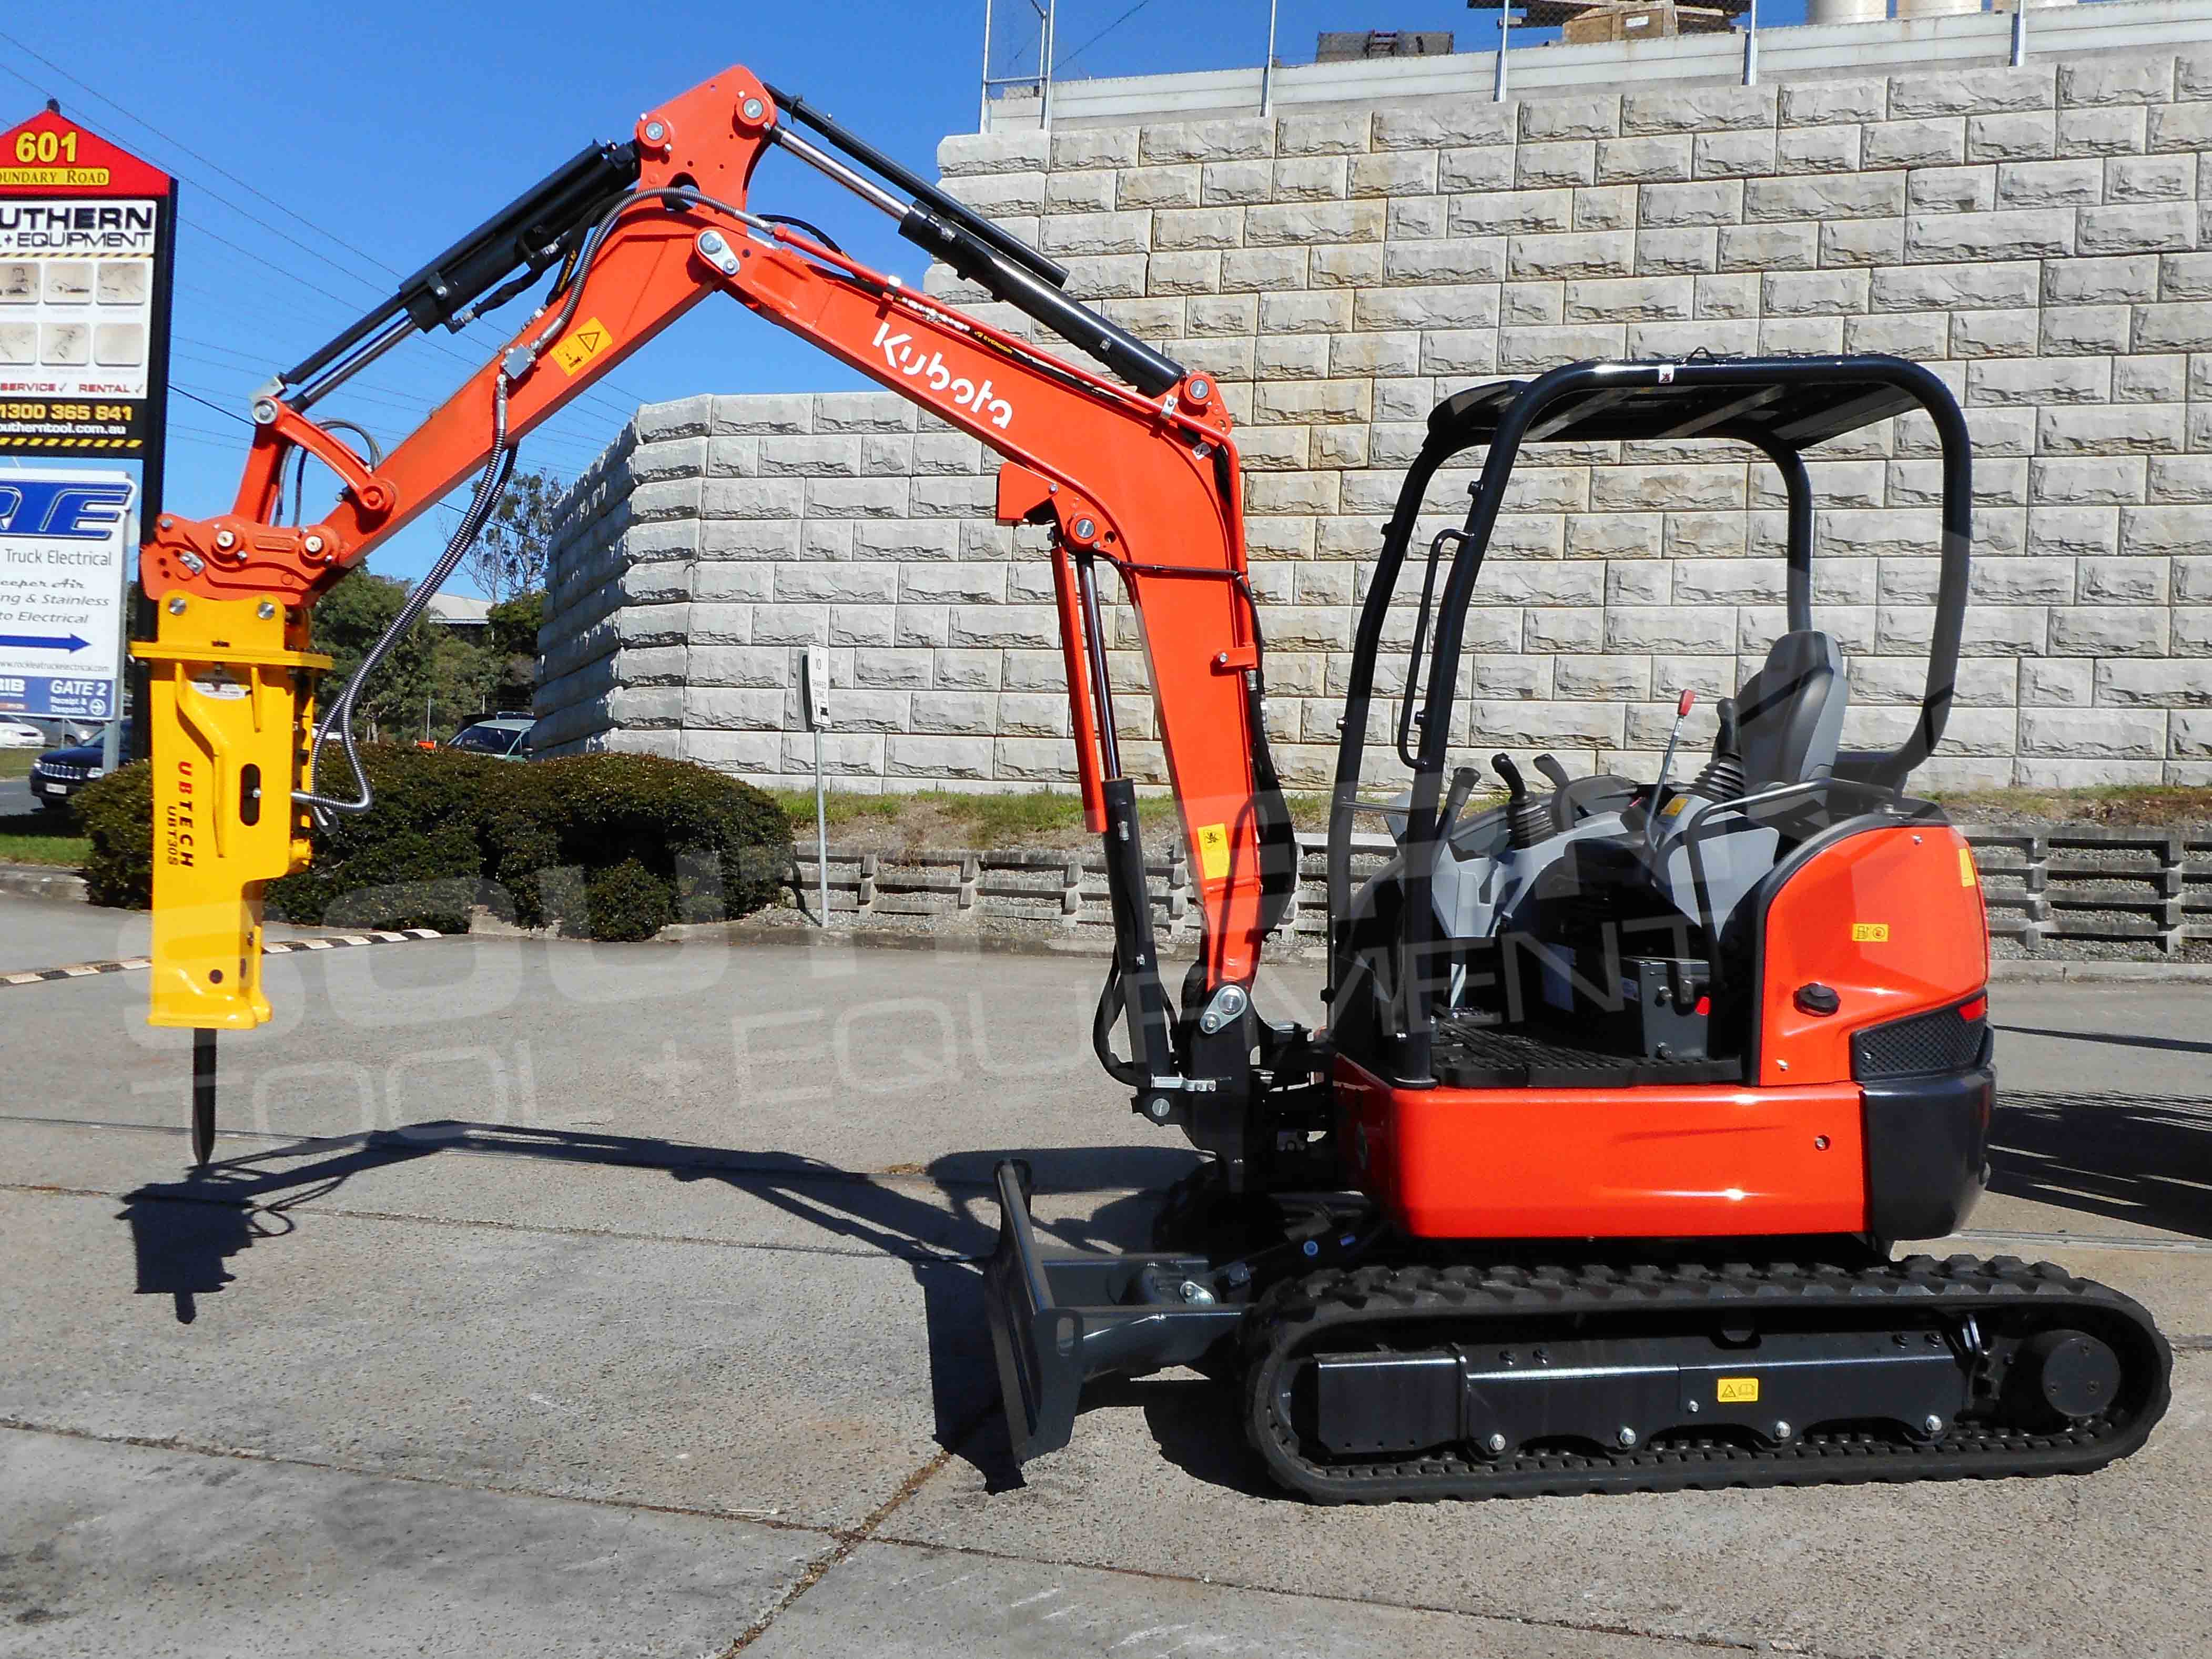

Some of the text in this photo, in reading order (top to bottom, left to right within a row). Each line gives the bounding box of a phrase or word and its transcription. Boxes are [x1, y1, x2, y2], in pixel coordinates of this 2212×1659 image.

[16, 131, 77, 162] 601
[0, 208, 153, 230] UTHERN
[17, 232, 151, 247] EQUIPMENT
[872, 321, 1013, 430] Kubota
[1, 383, 130, 393] SERVICE RENTAL
[0, 403, 132, 421] 1300 365 841
[5, 548, 111, 566] Truck Electrical
[26, 594, 37, 603] &
[42, 595, 110, 606] Stainless
[18, 612, 89, 624] Electrical
[51, 680, 94, 696] GATE
[96, 683, 107, 697] 2
[178, 761, 194, 867] UBTECH
